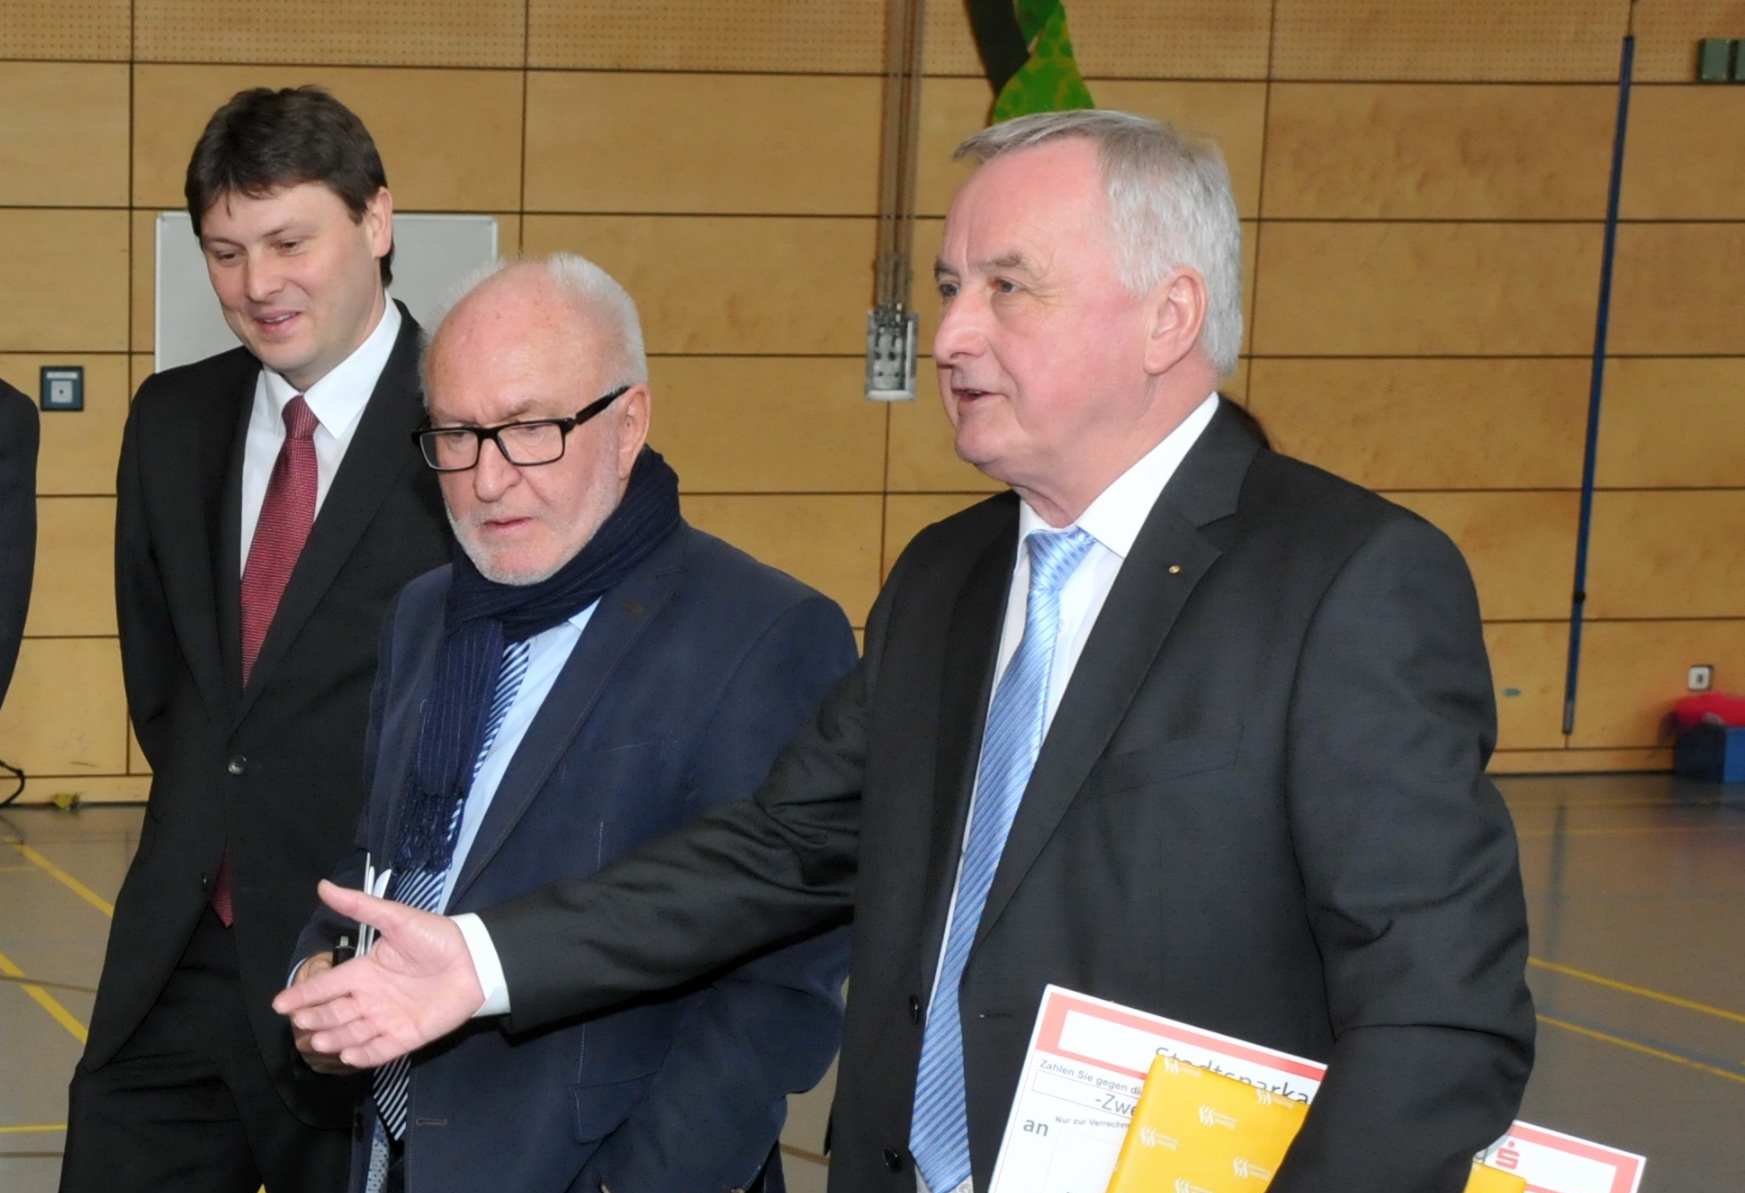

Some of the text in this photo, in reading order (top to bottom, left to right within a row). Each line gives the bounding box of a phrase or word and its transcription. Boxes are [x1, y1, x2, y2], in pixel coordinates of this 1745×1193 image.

[1040, 1059, 1075, 1077] Zahlen
[1077, 1070, 1094, 1082] Sie
[1096, 1077, 1128, 1092] gegen
[1023, 1119, 1049, 1137] an
[1055, 1115, 1071, 1124] Nur
[1073, 1118, 1087, 1126] zur
